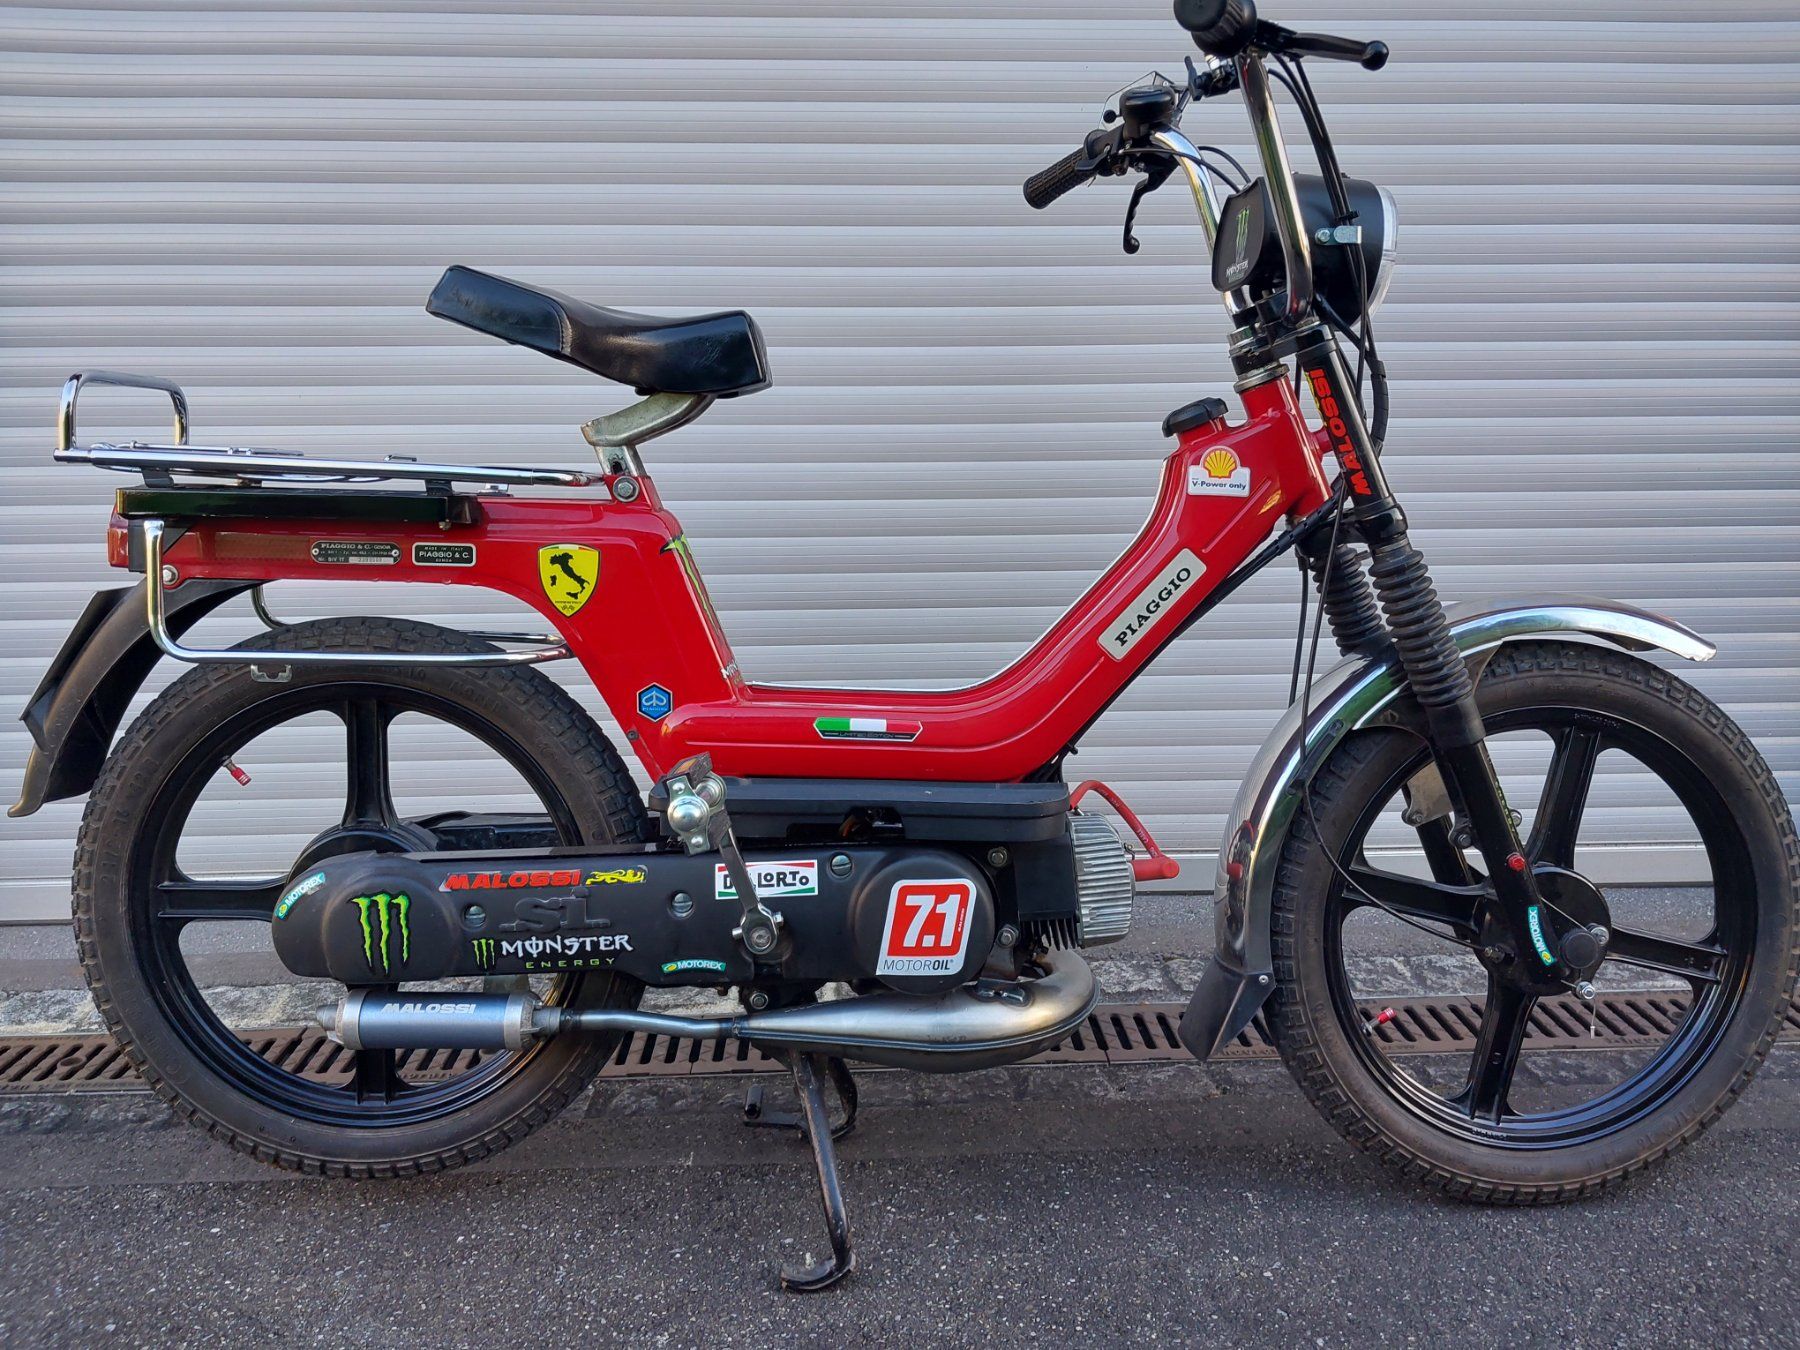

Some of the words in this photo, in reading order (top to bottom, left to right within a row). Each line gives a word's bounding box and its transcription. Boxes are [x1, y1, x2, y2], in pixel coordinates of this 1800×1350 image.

[1309, 368, 1372, 495] MALOSSI
[1191, 480, 1227, 488] V-Power
[1228, 482, 1247, 491] only
[418, 550, 453, 558] PIAGGIO
[1114, 567, 1191, 647] PIAGGIO
[444, 869, 582, 890] MALOSSI
[284, 874, 324, 907] MOTOREX
[902, 894, 961, 948] 7.1
[1529, 909, 1547, 952] MOTOREX
[525, 957, 616, 969] ENERGY
[676, 959, 724, 971] MOTOREX
[380, 1003, 477, 1014] MALOSSI
